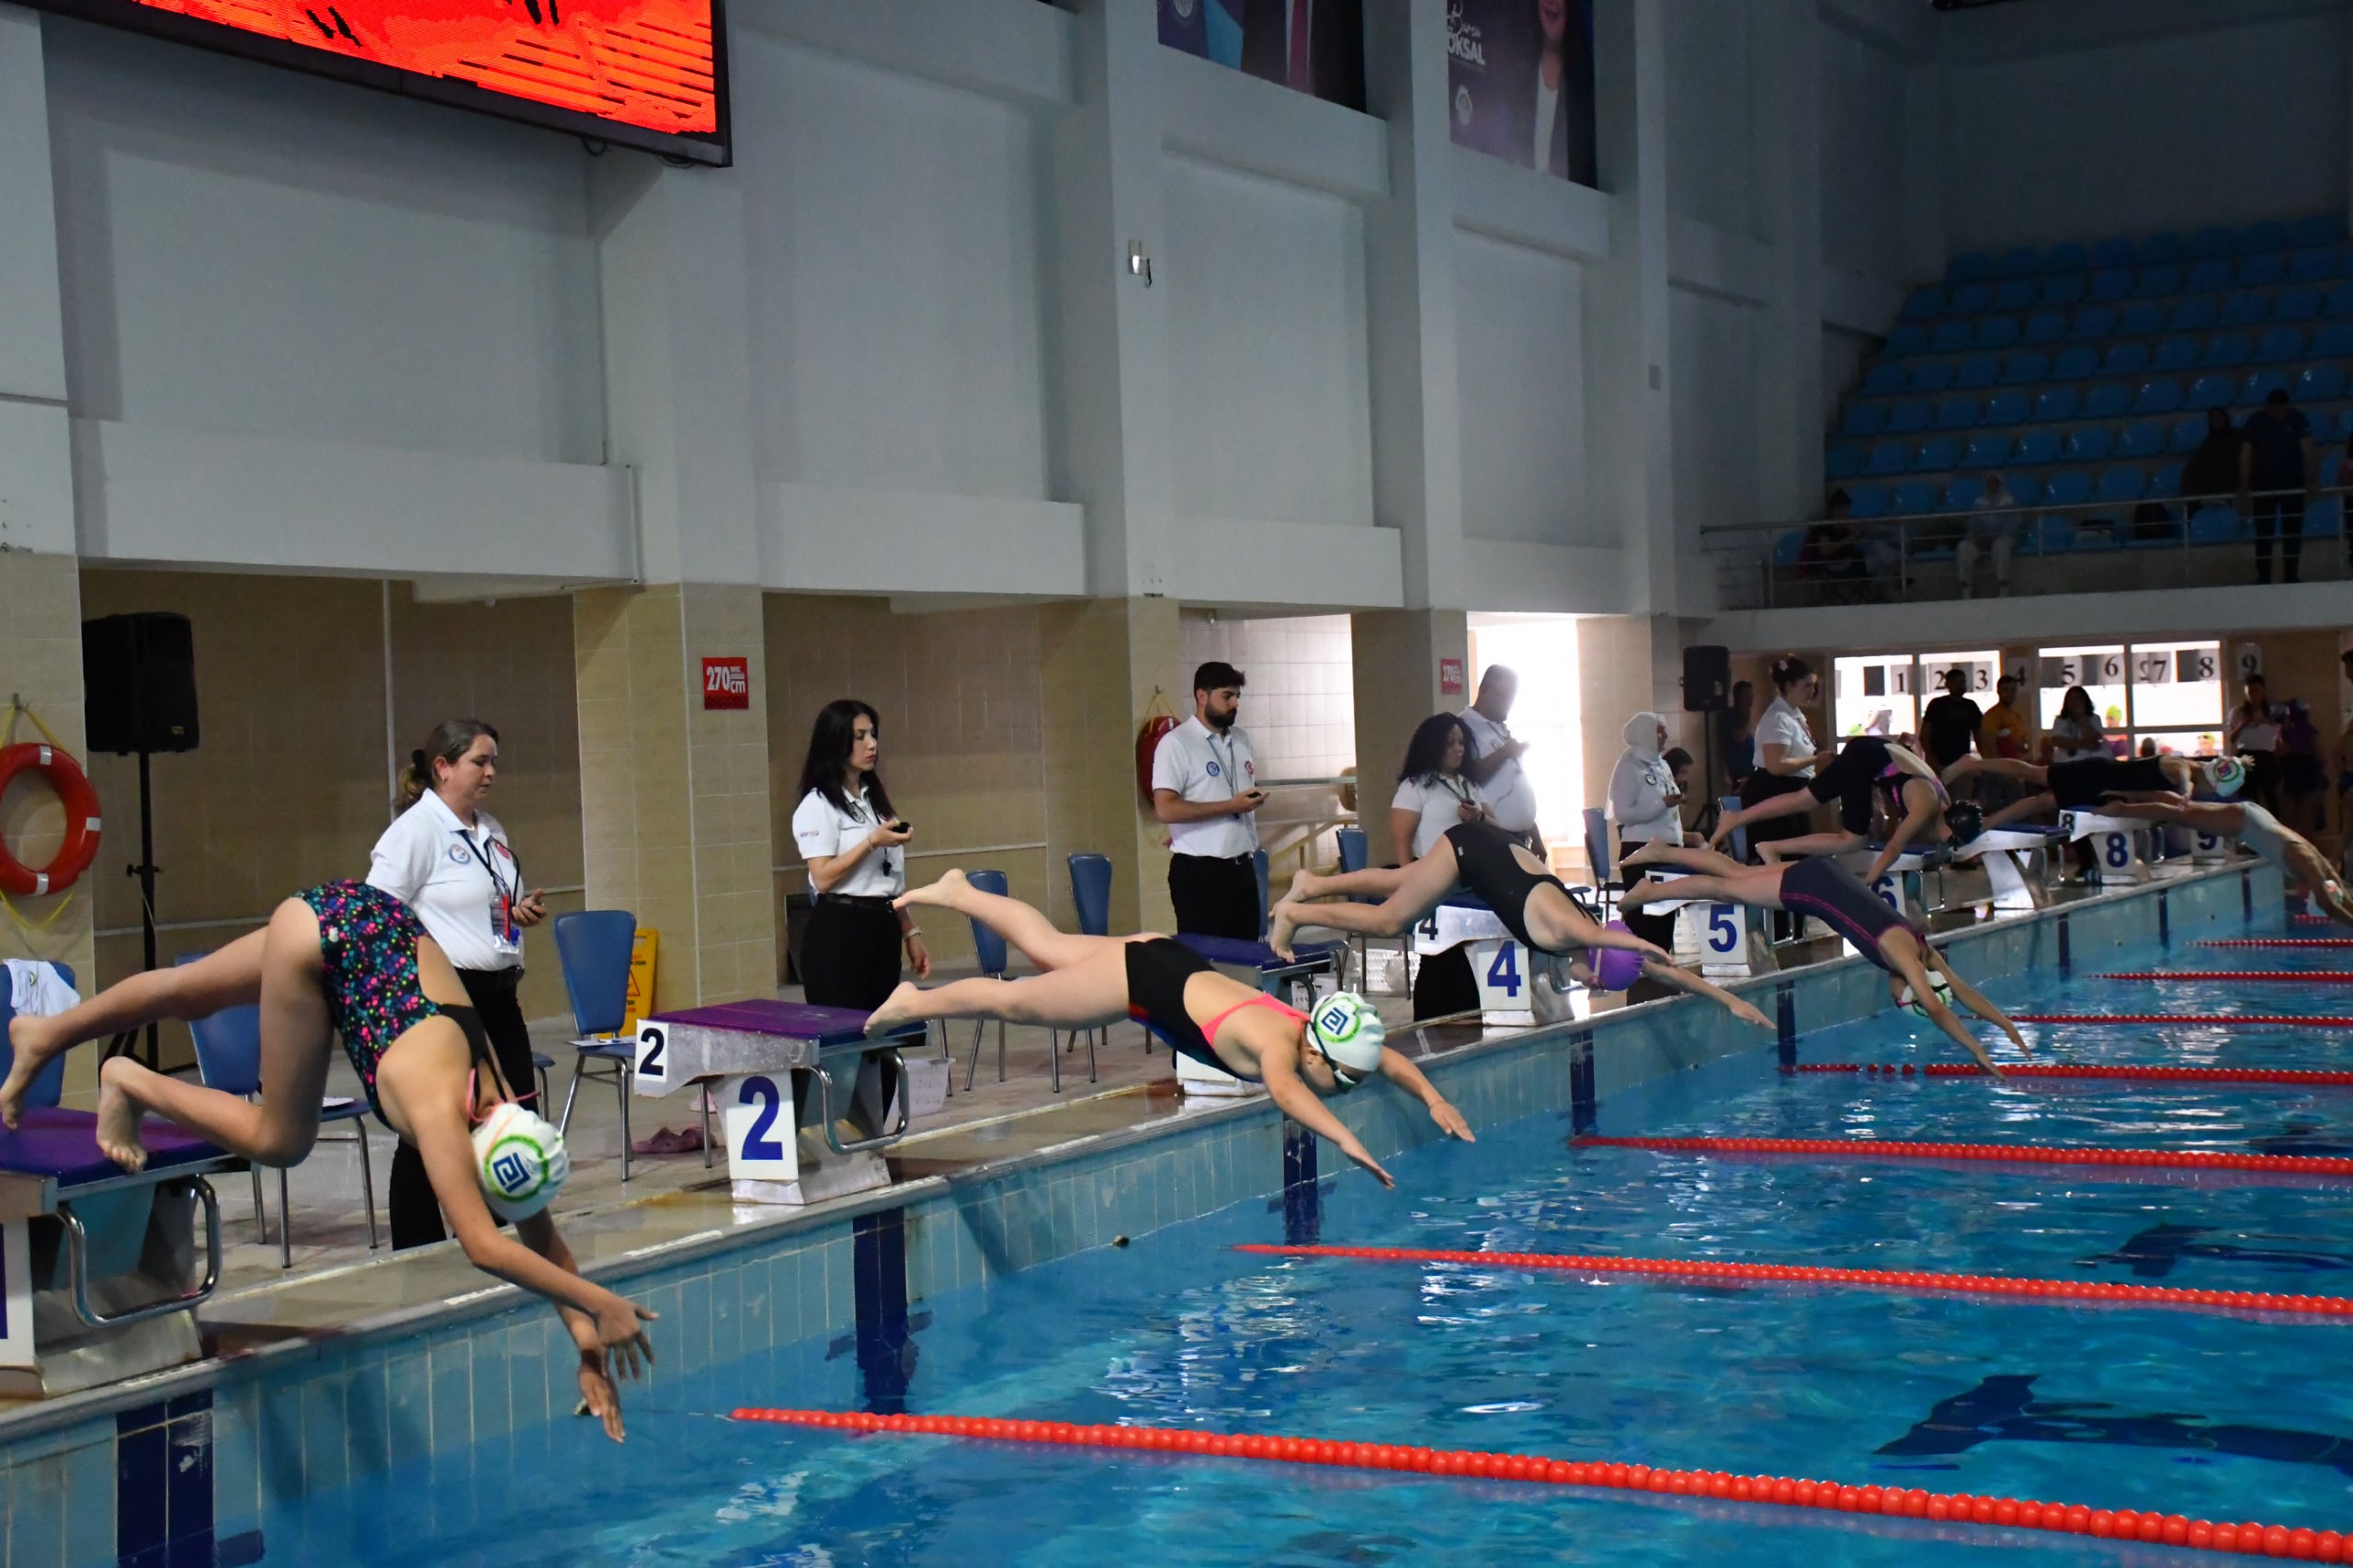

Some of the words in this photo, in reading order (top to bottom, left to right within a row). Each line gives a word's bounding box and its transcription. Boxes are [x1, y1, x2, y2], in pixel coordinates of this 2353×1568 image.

[2105, 655, 2119, 676] 6
[2154, 660, 2167, 680] 7
[2199, 656, 2214, 677] 8
[2242, 653, 2257, 674] 9
[707, 666, 731, 690] 270
[730, 680, 745, 694] cm
[1897, 672, 1905, 692] 1
[1934, 670, 1948, 689] 2
[1975, 669, 1988, 689] 3
[2061, 664, 2075, 685] 5
[2062, 813, 2075, 832] 8
[2106, 832, 2128, 868] 8
[1418, 915, 1438, 941] 4
[1709, 904, 1737, 952] 5
[1487, 940, 1521, 997] 4
[638, 1027, 665, 1076] 2
[738, 1075, 783, 1160] 2
